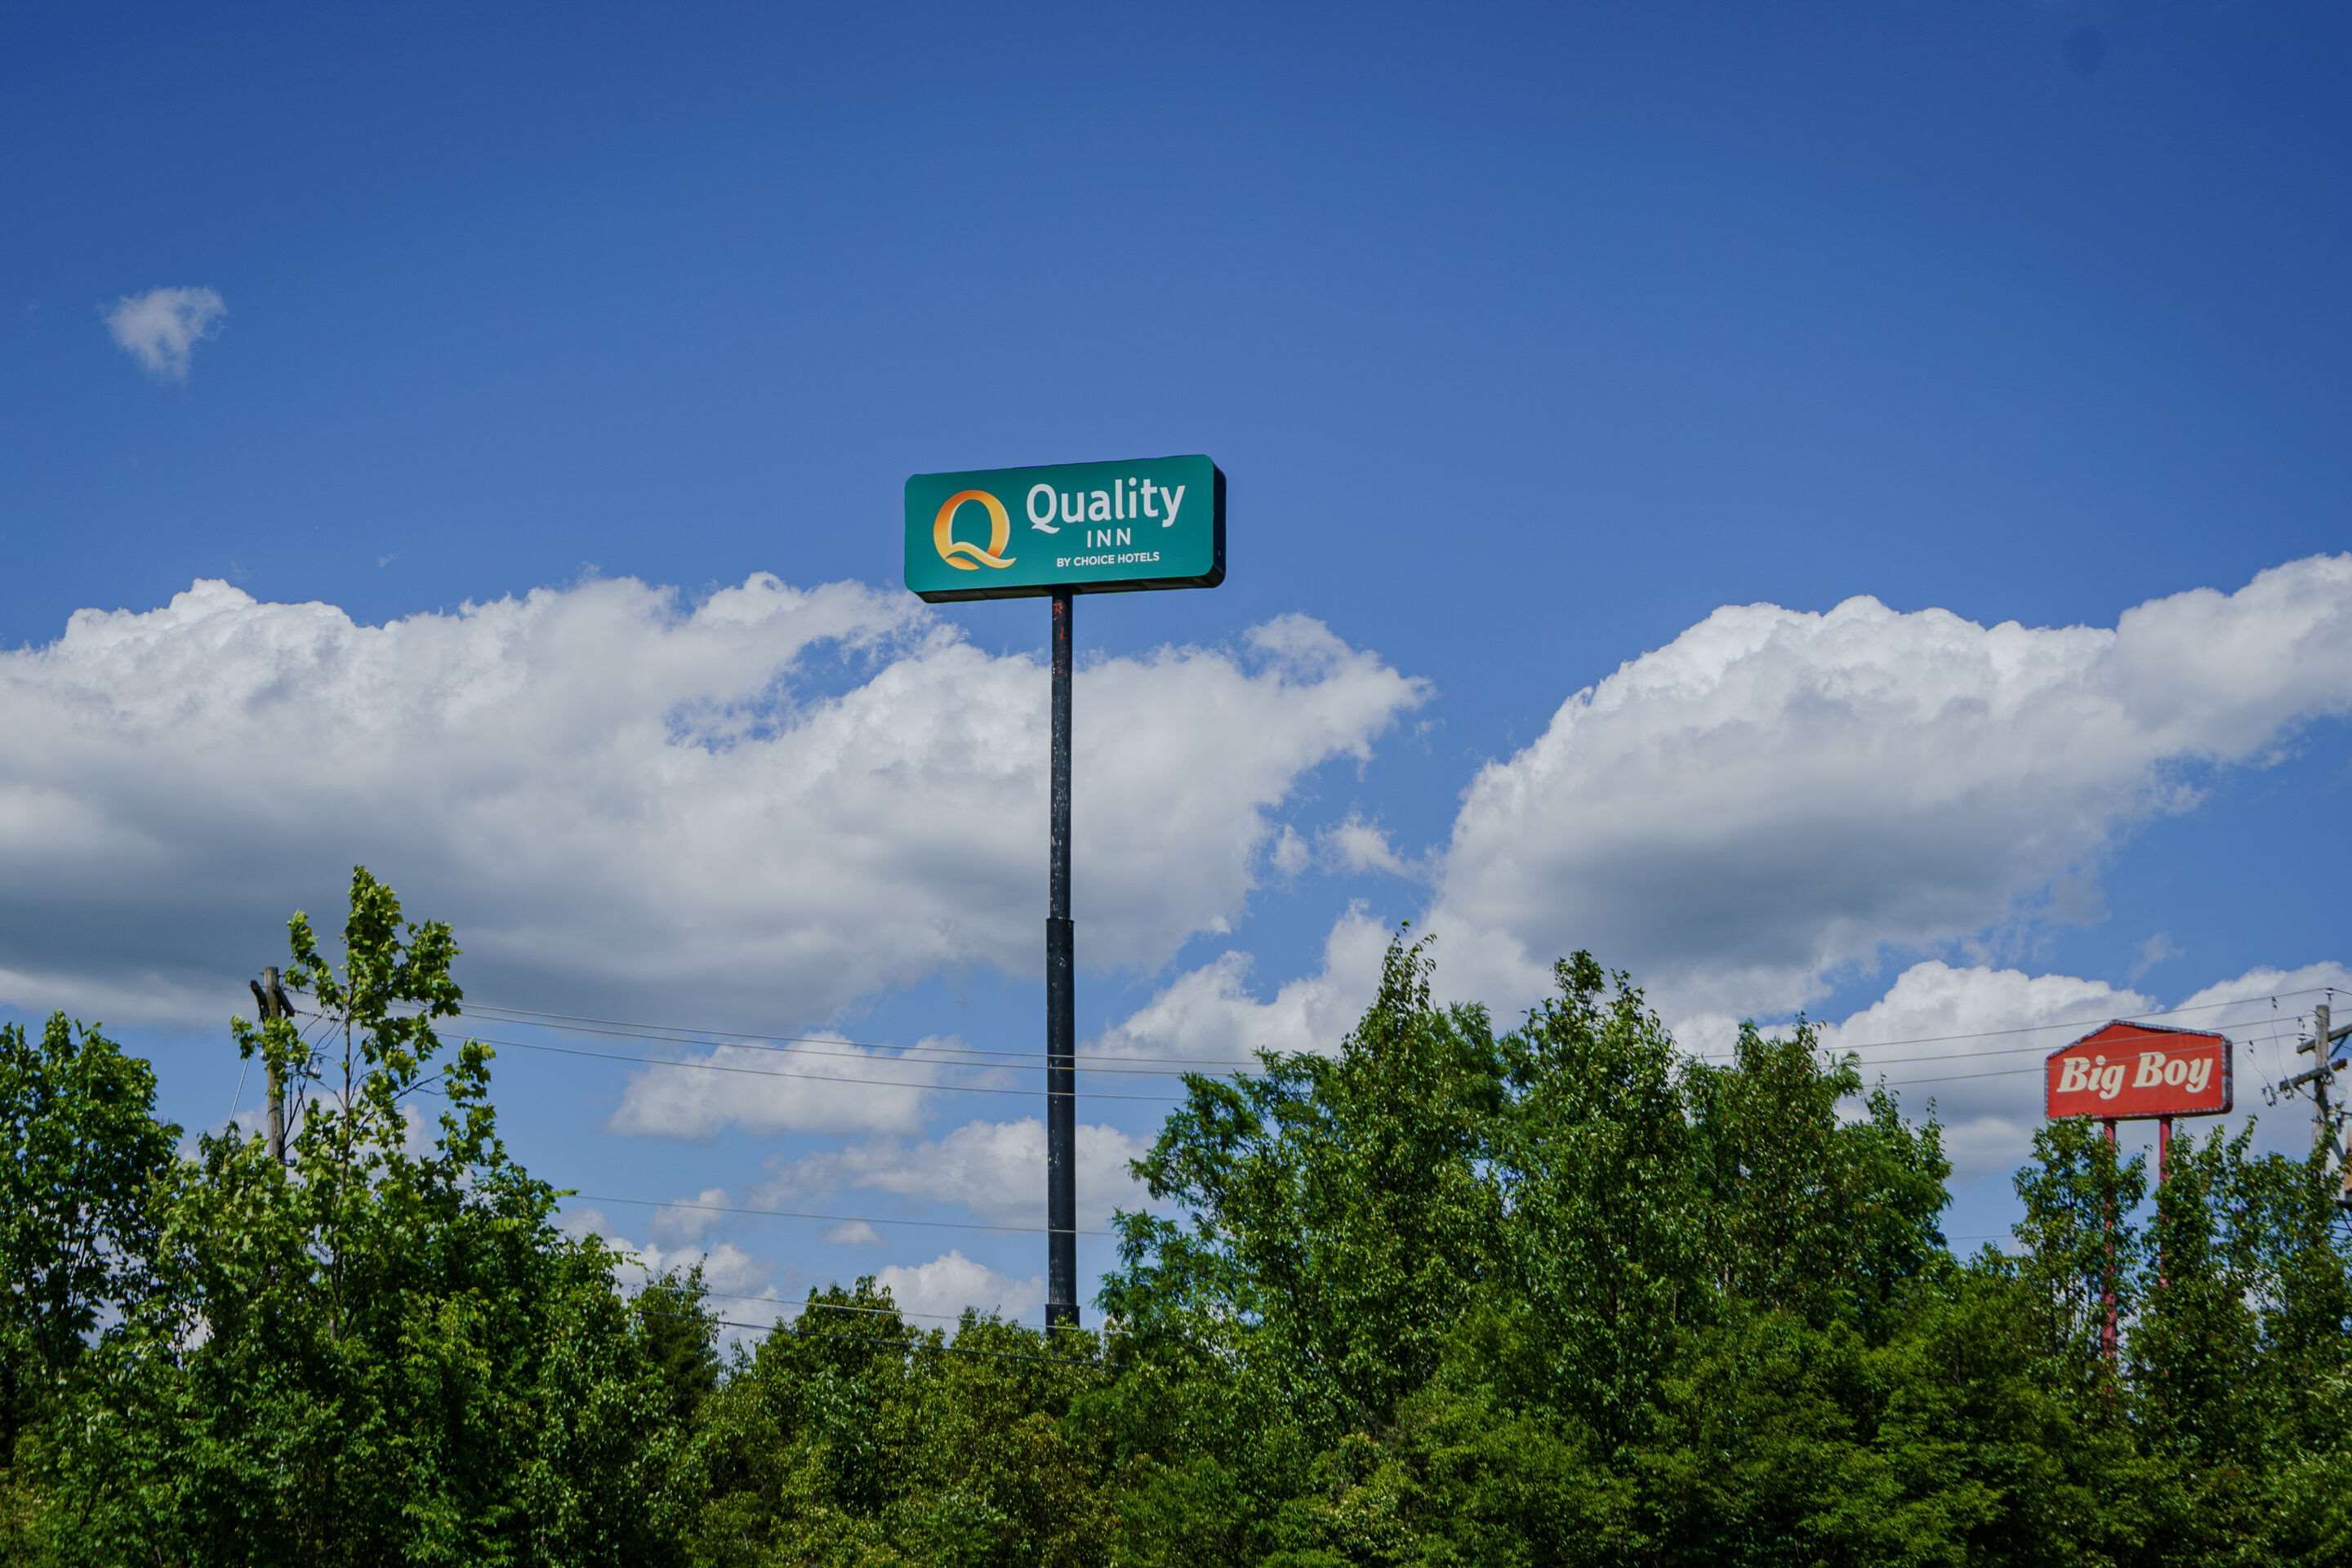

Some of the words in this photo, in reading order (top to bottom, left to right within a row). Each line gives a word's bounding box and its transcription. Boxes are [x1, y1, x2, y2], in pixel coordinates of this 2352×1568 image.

[933, 489, 1017, 570] Q
[1026, 477, 1186, 534] Quality
[1056, 557, 1071, 568] BY
[1073, 554, 1115, 567] CHOICE
[1117, 551, 1160, 564] HOTELS
[1086, 528, 1132, 549] INN
[2056, 1054, 2126, 1100] Big
[2132, 1051, 2214, 1094] Boy
